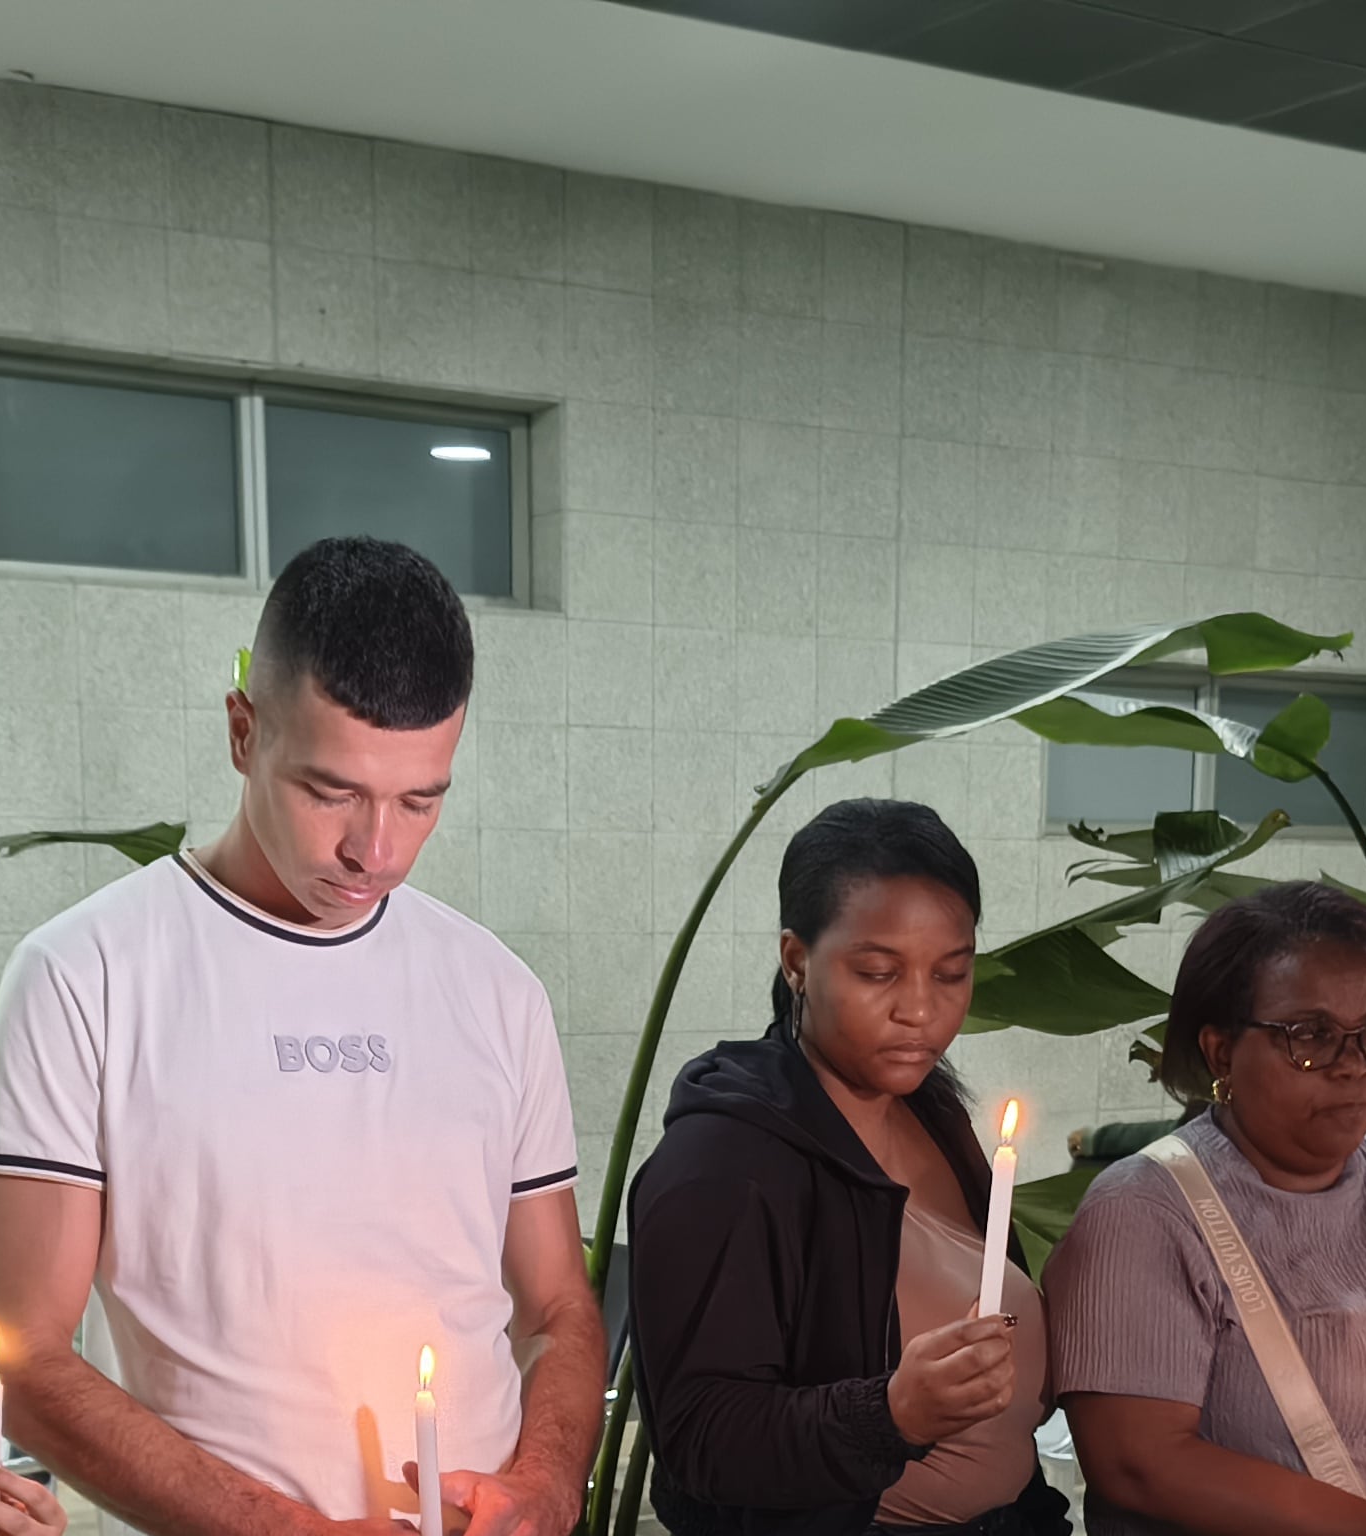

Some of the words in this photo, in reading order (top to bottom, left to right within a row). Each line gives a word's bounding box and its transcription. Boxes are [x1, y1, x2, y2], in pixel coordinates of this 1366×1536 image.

[274, 1034, 391, 1073] BOSS
[1195, 1198, 1238, 1263] VUITTON
[1230, 1263, 1266, 1313] LOUIS
